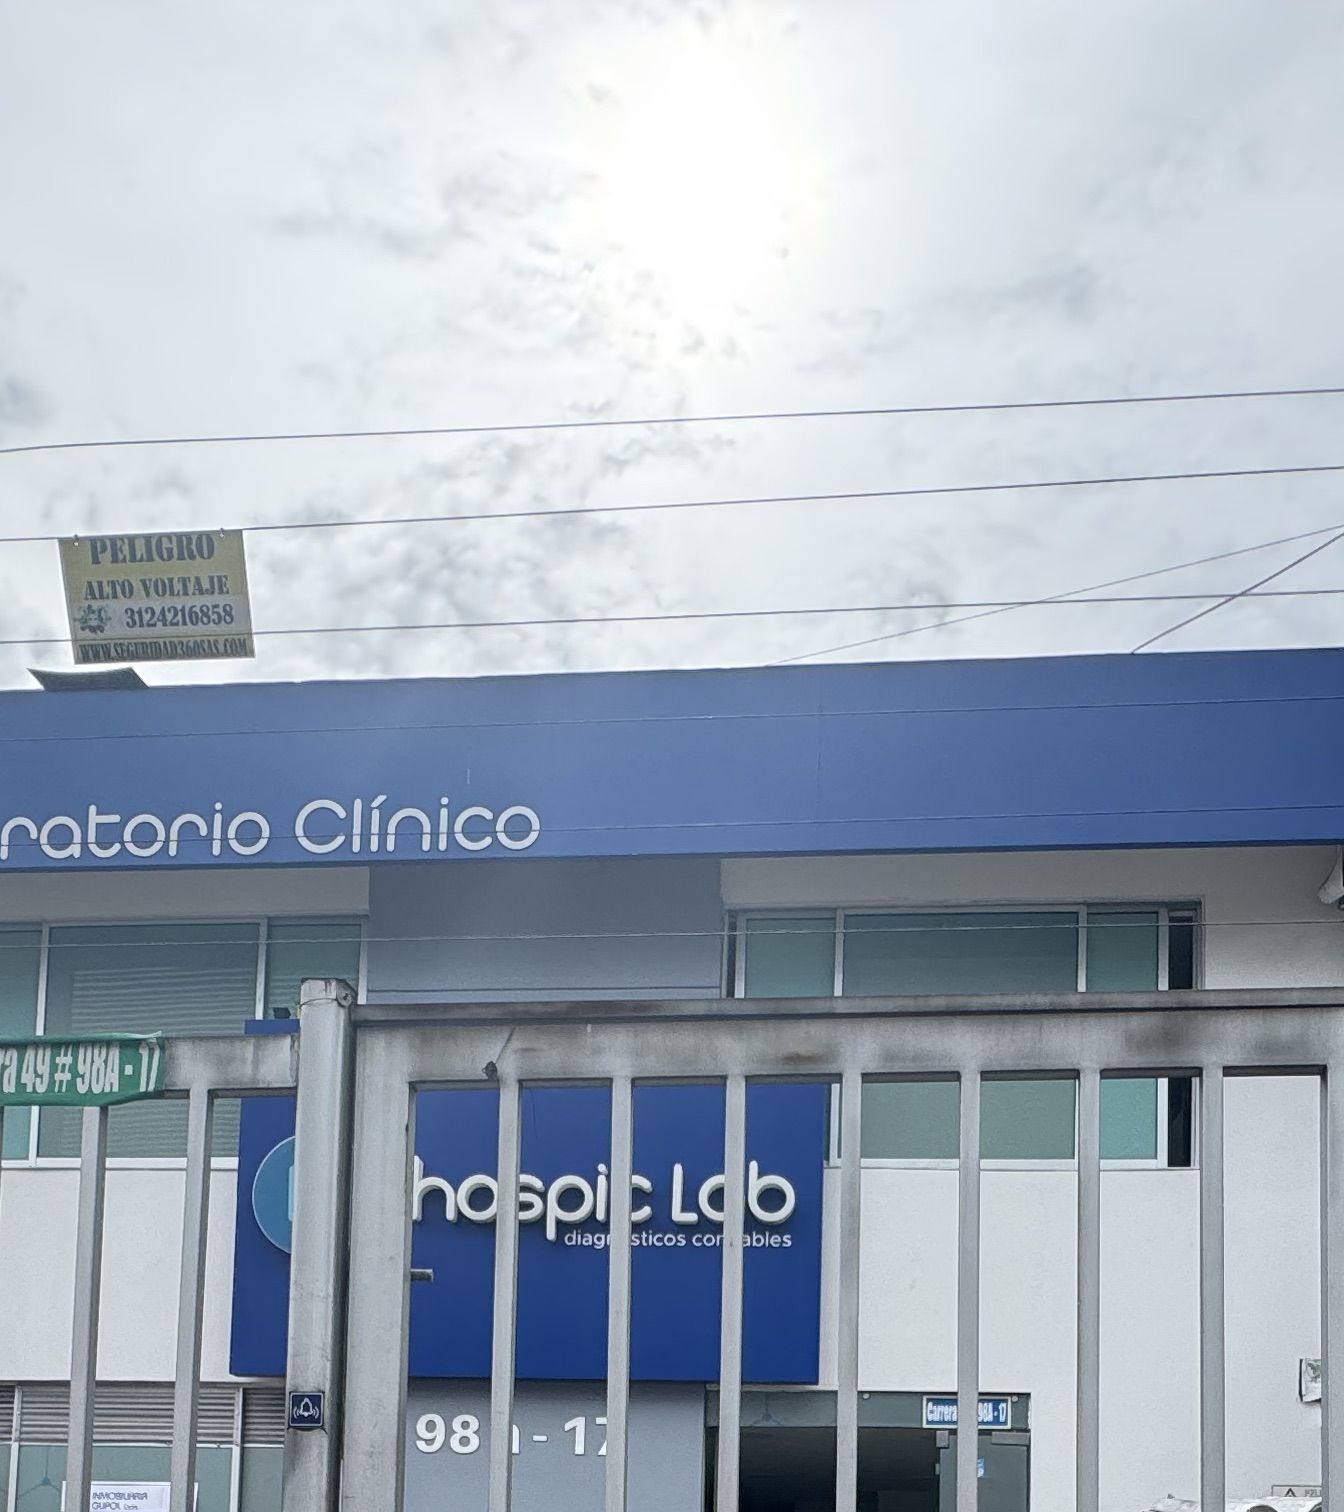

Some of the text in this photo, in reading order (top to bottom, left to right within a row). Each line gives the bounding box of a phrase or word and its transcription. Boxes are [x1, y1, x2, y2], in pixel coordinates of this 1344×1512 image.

[88, 533, 215, 565] PELIGRO
[84, 574, 230, 601] ALTO VOLTAJE
[124, 603, 235, 629] 3124216858
[294, 794, 541, 855] Clínico
[21, 1044, 52, 1094] 49
[76, 1043, 121, 1094] 98A
[927, 1401, 957, 1422] Carrera
